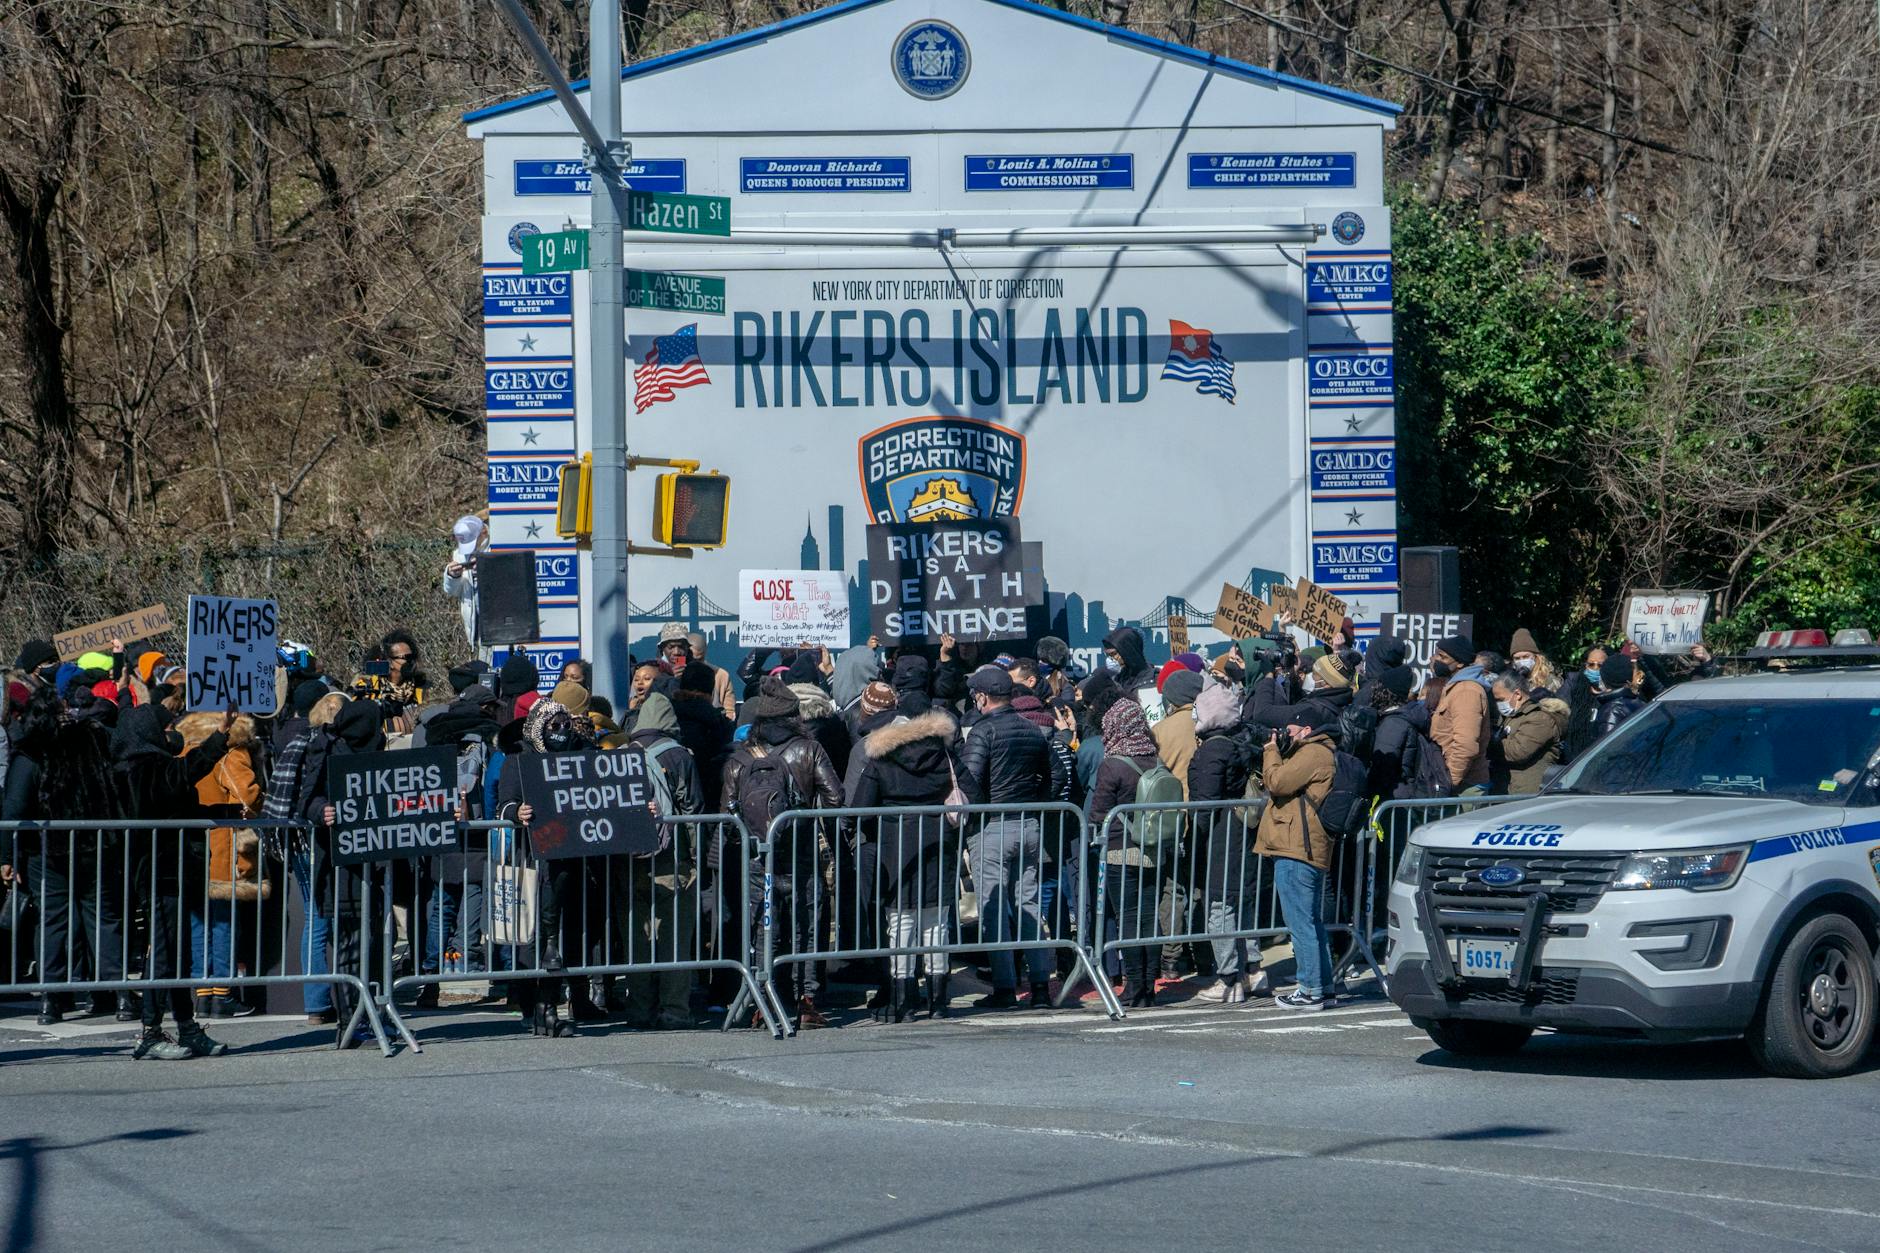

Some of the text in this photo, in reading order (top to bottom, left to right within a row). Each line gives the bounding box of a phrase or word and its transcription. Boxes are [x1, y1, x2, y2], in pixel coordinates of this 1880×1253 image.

[554, 163, 583, 175] Eric
[767, 161, 882, 172] Donovan Richards
[998, 158, 1098, 170] Louis A. Molina
[1221, 156, 1322, 167] Kenneth Stukes
[747, 177, 905, 189] QUEENS BOROUGH PRESIDENT
[1000, 175, 1098, 187] COMMISSIONER
[1214, 173, 1331, 182] CHIEF of DEPARTMENT
[633, 197, 722, 229] Hazen St
[537, 238, 555, 268] 19
[563, 237, 577, 255] Av
[655, 275, 702, 293] AVENUE
[1313, 264, 1387, 283] AMKC
[486, 277, 567, 296] EMTC
[813, 278, 1063, 301] NEW YORK CITY DEPARTMENT OF CORRECTION
[629, 289, 725, 312] OF THE BOLDEST
[734, 307, 1148, 408] RIKERS ISLAND
[1315, 358, 1388, 377] OBCC
[490, 371, 568, 390] GRVC
[870, 427, 1014, 462] CORRECTION
[870, 448, 1014, 484] DEPARTMENT
[1315, 451, 1392, 471] GMDC
[489, 464, 562, 483] RND
[518, 492, 547, 500] CENTER
[886, 530, 1003, 561] RIKERS
[1317, 545, 1394, 564] RMSC
[536, 557, 570, 576] TC
[916, 555, 970, 576] IS A
[753, 579, 831, 601] CLOSE The
[871, 571, 1023, 606] DEATH
[1235, 589, 1265, 611] FREE
[1305, 600, 1328, 621] IS A
[1307, 584, 1348, 617] RIKERS
[142, 610, 168, 631] NOW
[1237, 603, 1260, 621] OUR
[1301, 609, 1336, 634] DEATH
[742, 620, 764, 632] Rikers
[885, 607, 1027, 639] SENTENCE
[1231, 624, 1257, 640] NO
[1290, 617, 1334, 646] SENTENC
[1392, 613, 1460, 640] FREE
[57, 619, 139, 656] DECARCERATE
[1633, 622, 1657, 647] FREE
[216, 639, 254, 653] is a
[188, 653, 252, 707] DEATH
[542, 753, 644, 782] LET OUR
[345, 765, 442, 798] RIKERS
[335, 787, 461, 825] IS A DEATH
[553, 782, 646, 814] PEOPLE
[338, 820, 457, 855] SENTENCE
[580, 818, 614, 843] GO
[1496, 824, 1563, 832] NYPD
[1471, 832, 1565, 847] POLICE
[1790, 827, 1845, 852] POLICE
[1486, 868, 1512, 880] Ford
[1466, 950, 1502, 969] 5057
